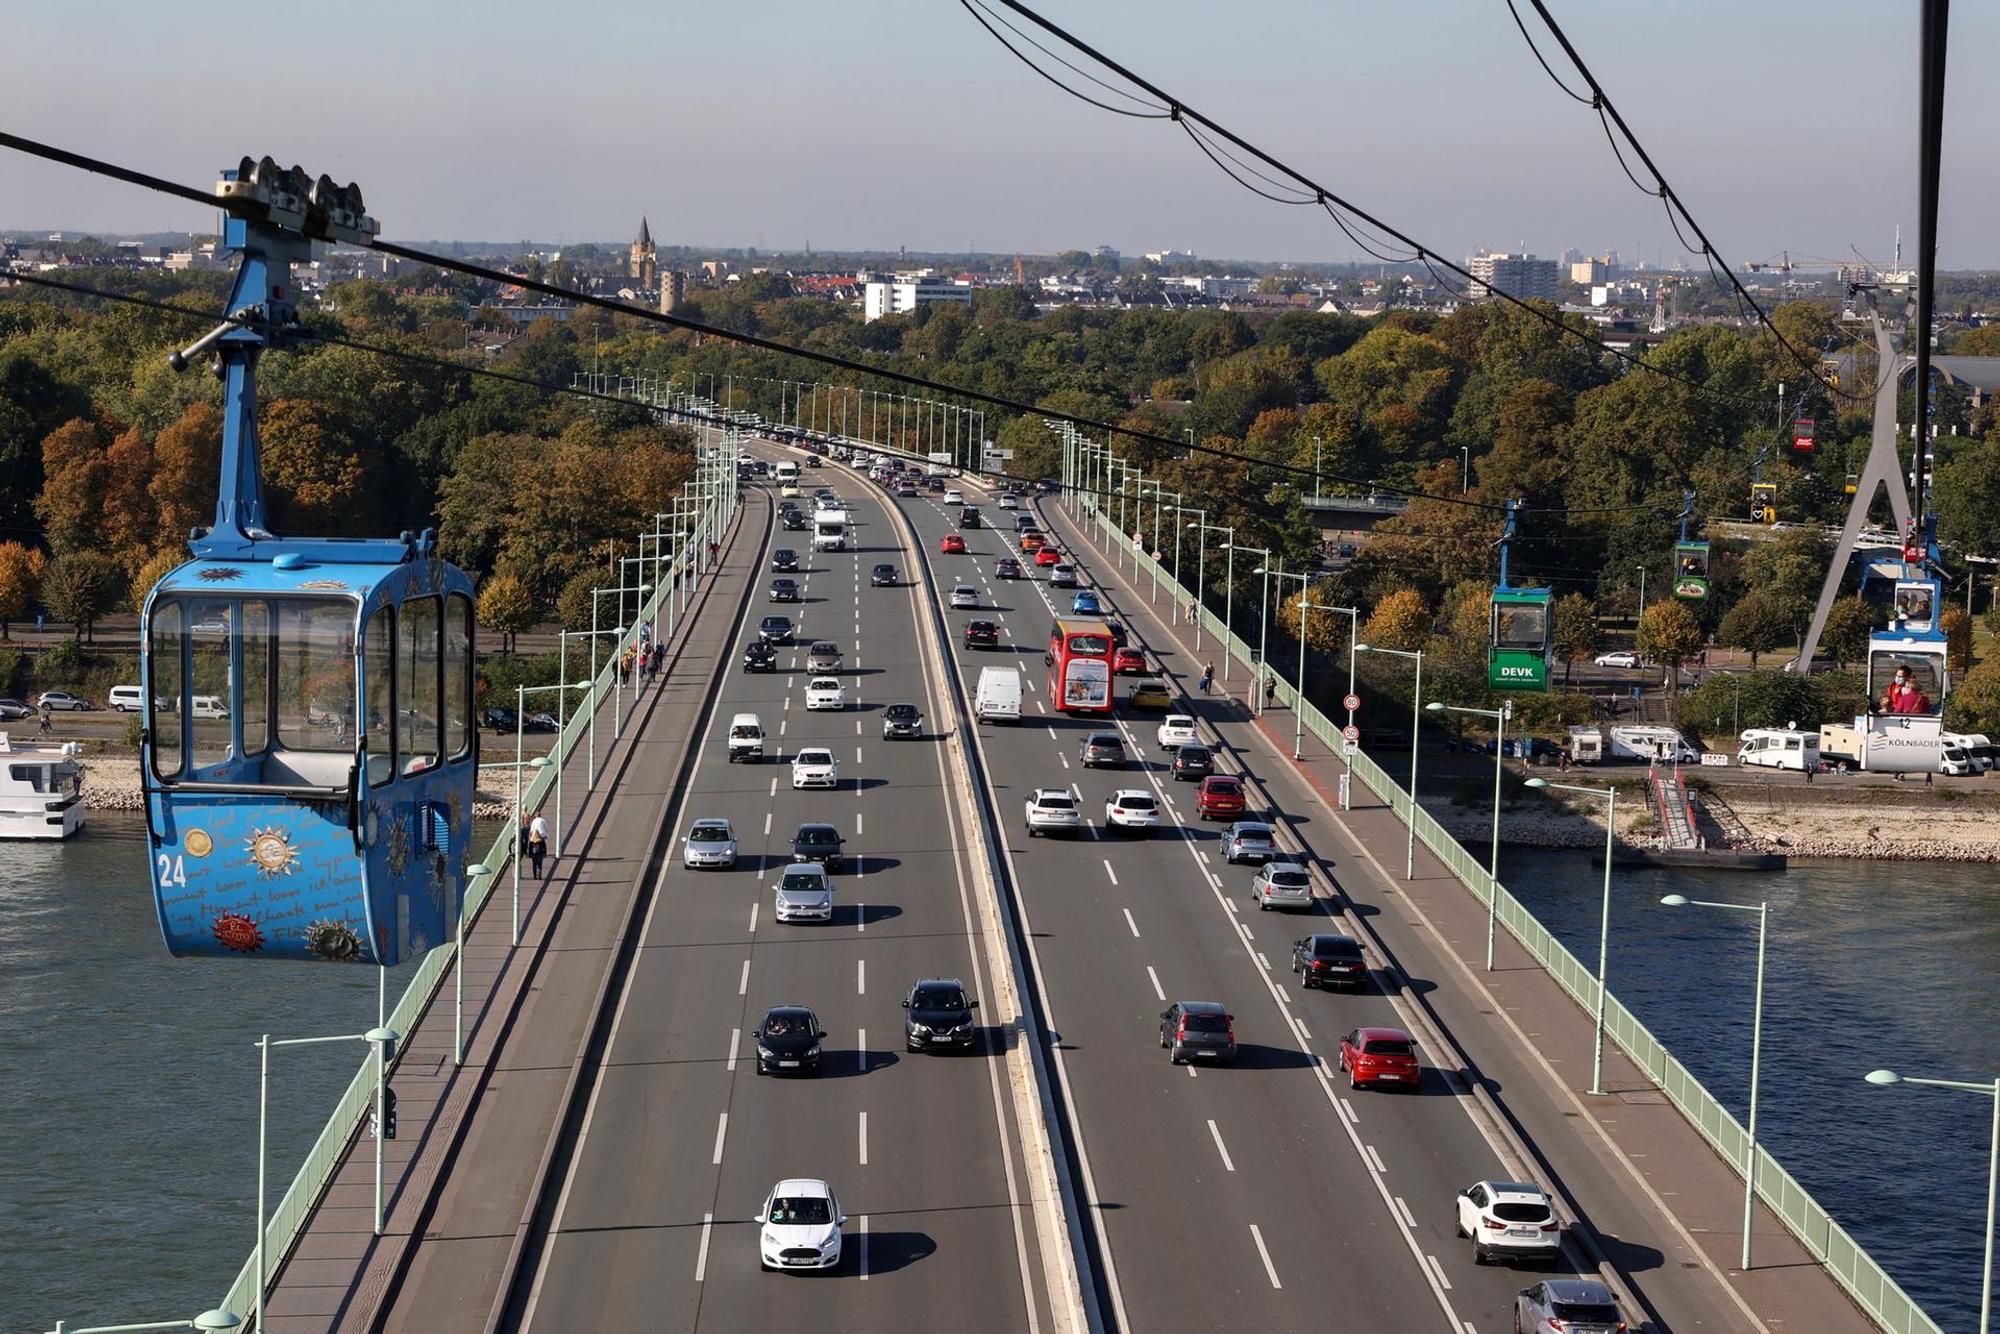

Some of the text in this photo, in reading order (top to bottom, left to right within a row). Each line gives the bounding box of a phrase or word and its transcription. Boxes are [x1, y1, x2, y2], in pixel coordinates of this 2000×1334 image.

[1501, 667, 1533, 677] DEVK
[1899, 718, 1911, 729] 12
[1346, 729, 1356, 737] 50
[157, 854, 186, 888] 24
